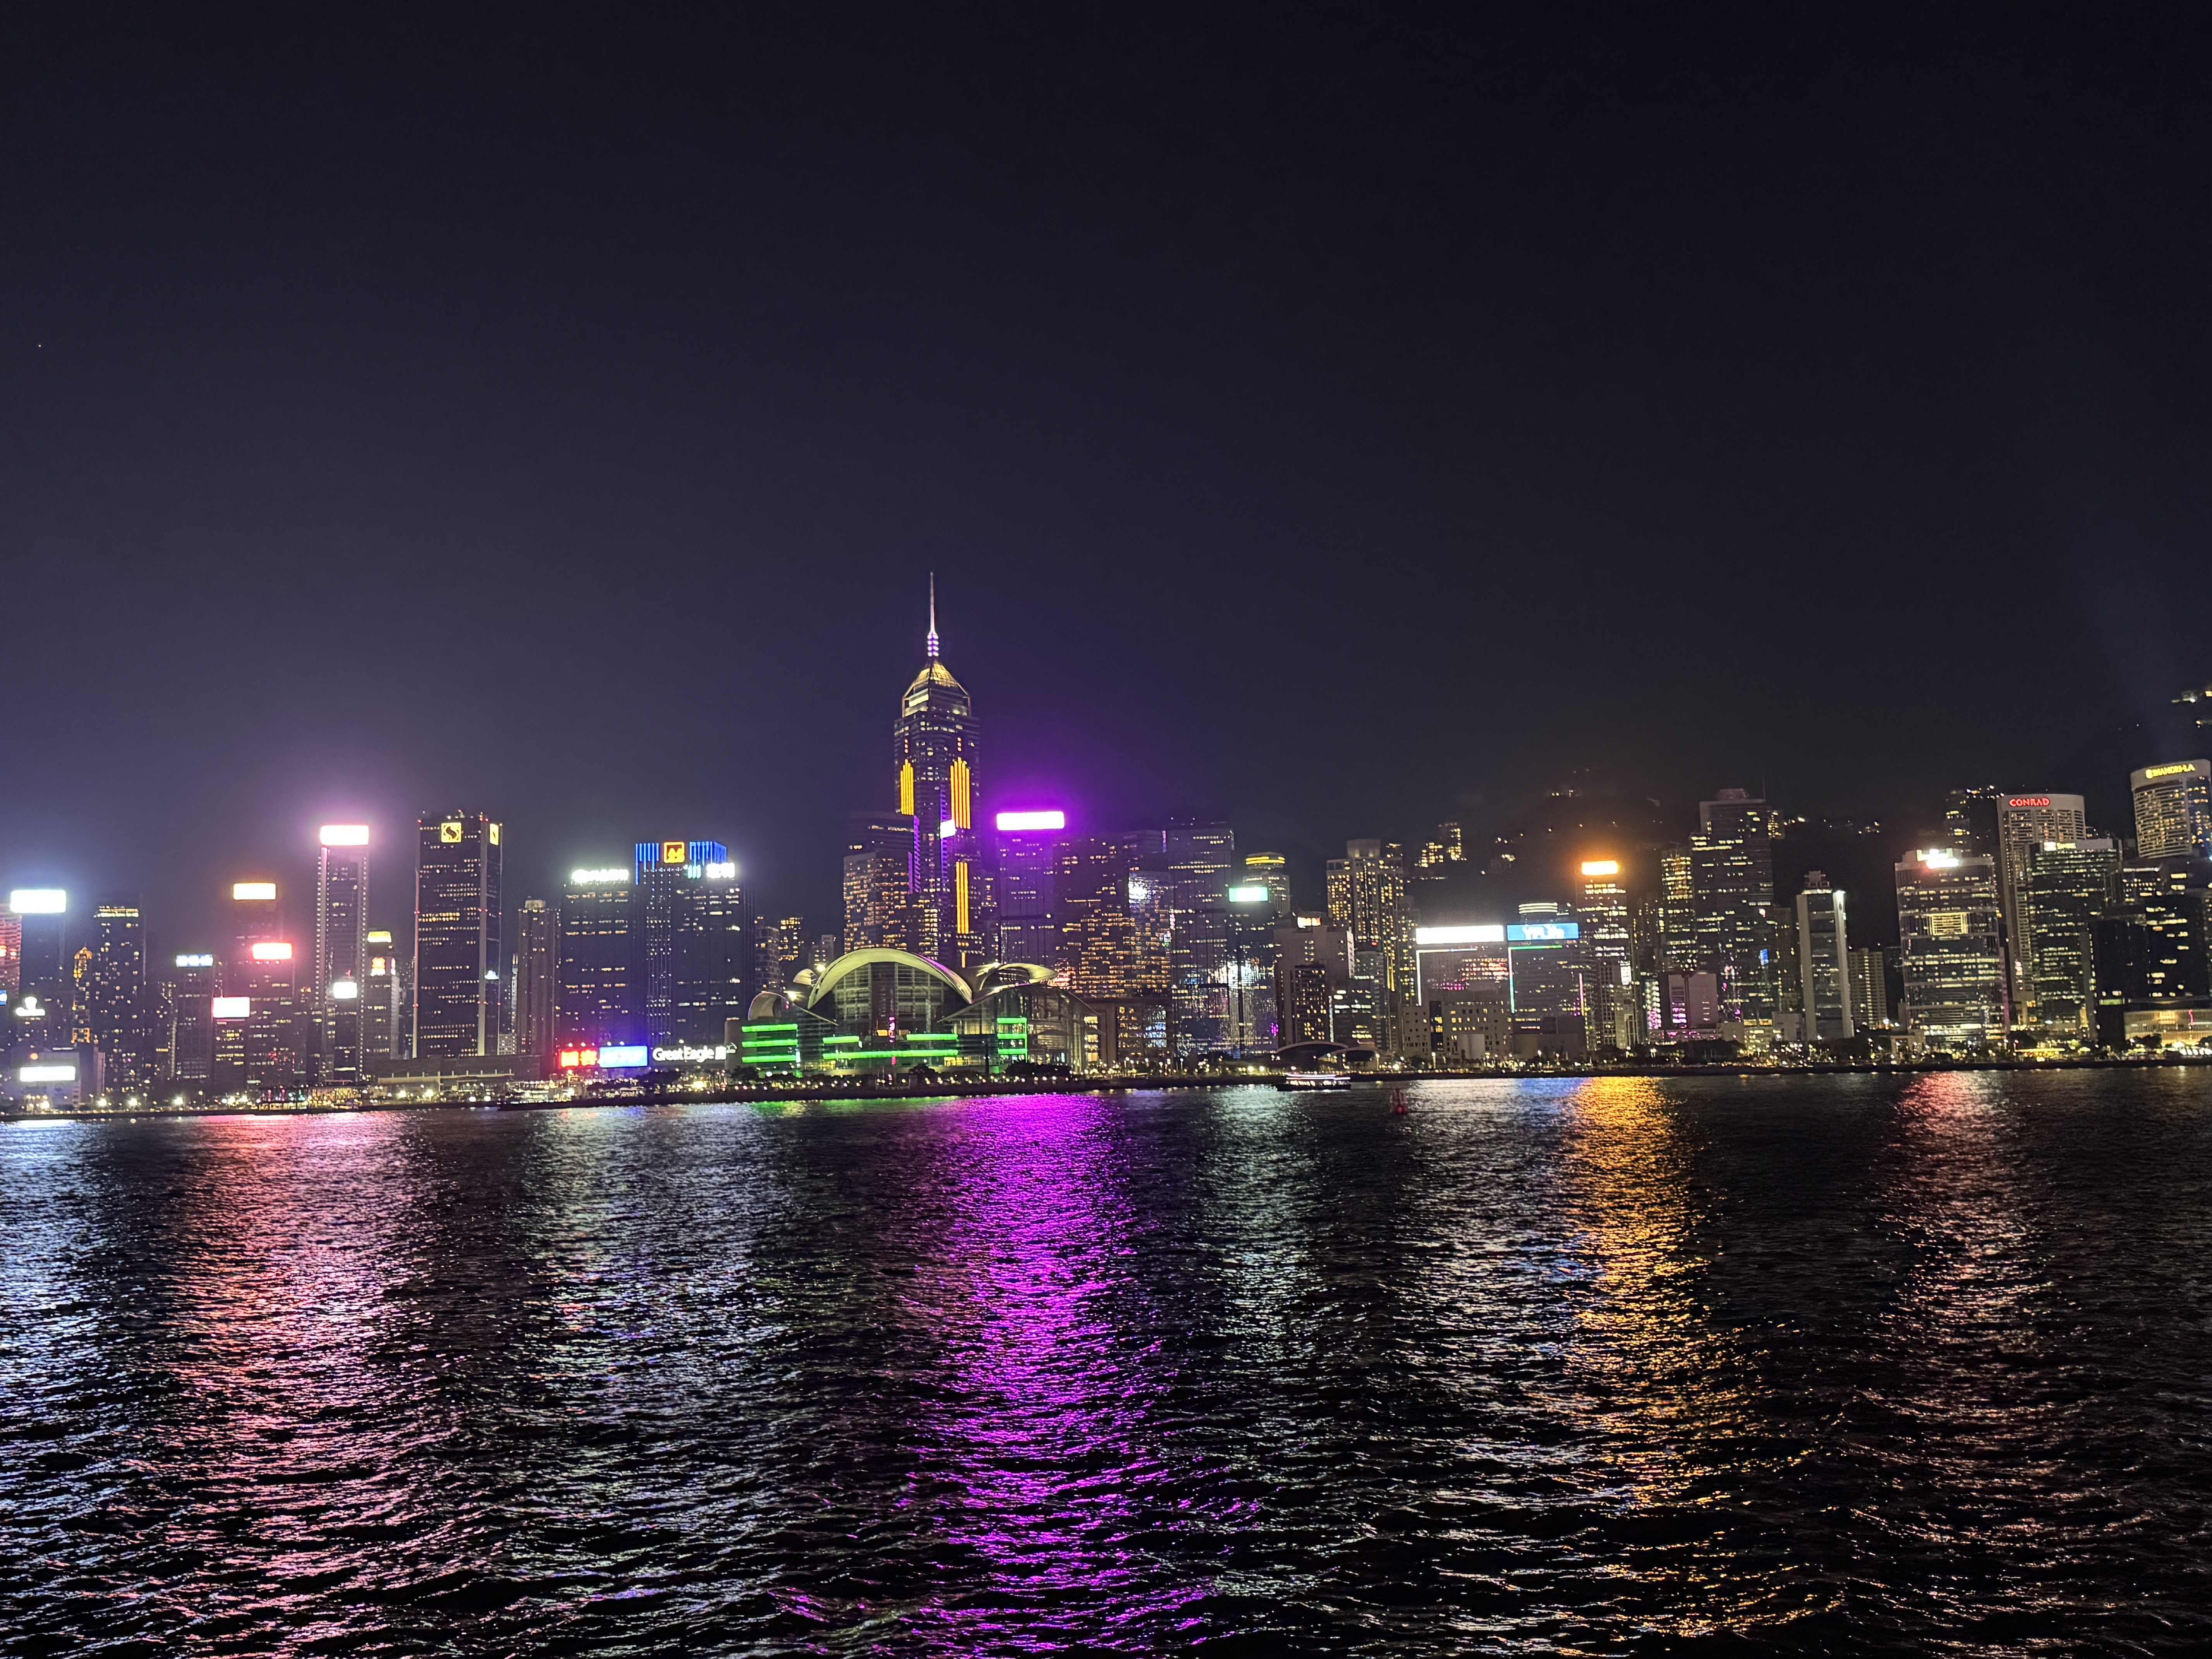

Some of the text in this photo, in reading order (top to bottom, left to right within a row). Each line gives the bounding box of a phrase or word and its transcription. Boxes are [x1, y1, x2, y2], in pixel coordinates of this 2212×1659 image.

[2152, 763, 2195, 777] SHANGRI-LA
[2009, 798, 2050, 807] CONRAD
[652, 1047, 684, 1061] Great
[684, 1045, 715, 1063] Eagle
